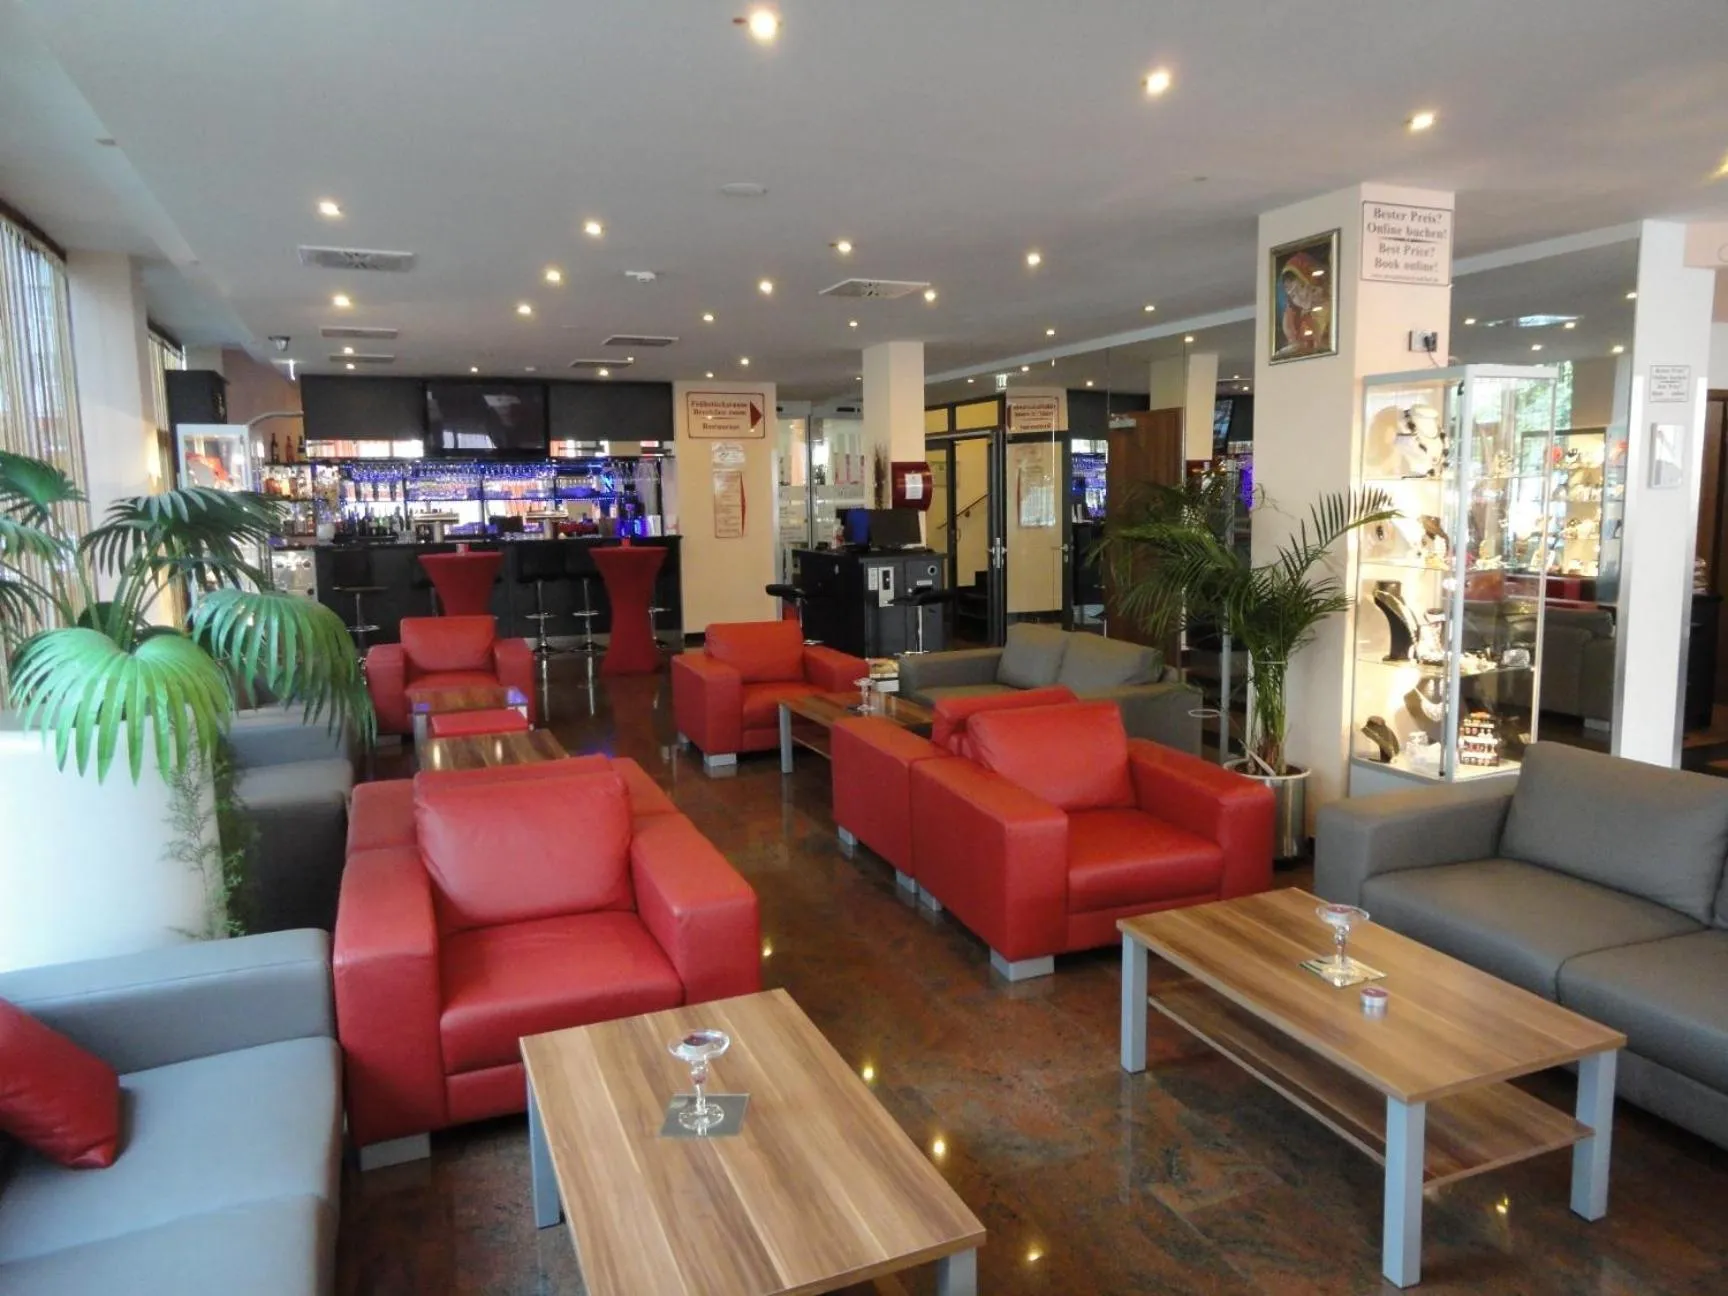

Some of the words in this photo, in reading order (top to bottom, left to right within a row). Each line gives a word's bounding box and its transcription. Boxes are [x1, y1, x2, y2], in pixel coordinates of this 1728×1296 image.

[1374, 207, 1407, 220] Bester
[1410, 210, 1442, 224] Preis?
[1367, 222, 1402, 235] Online
[1406, 226, 1447, 239] buchen!
[1379, 243, 1401, 254] Best
[1403, 245, 1435, 257] Price?
[1375, 257, 1399, 269] Book
